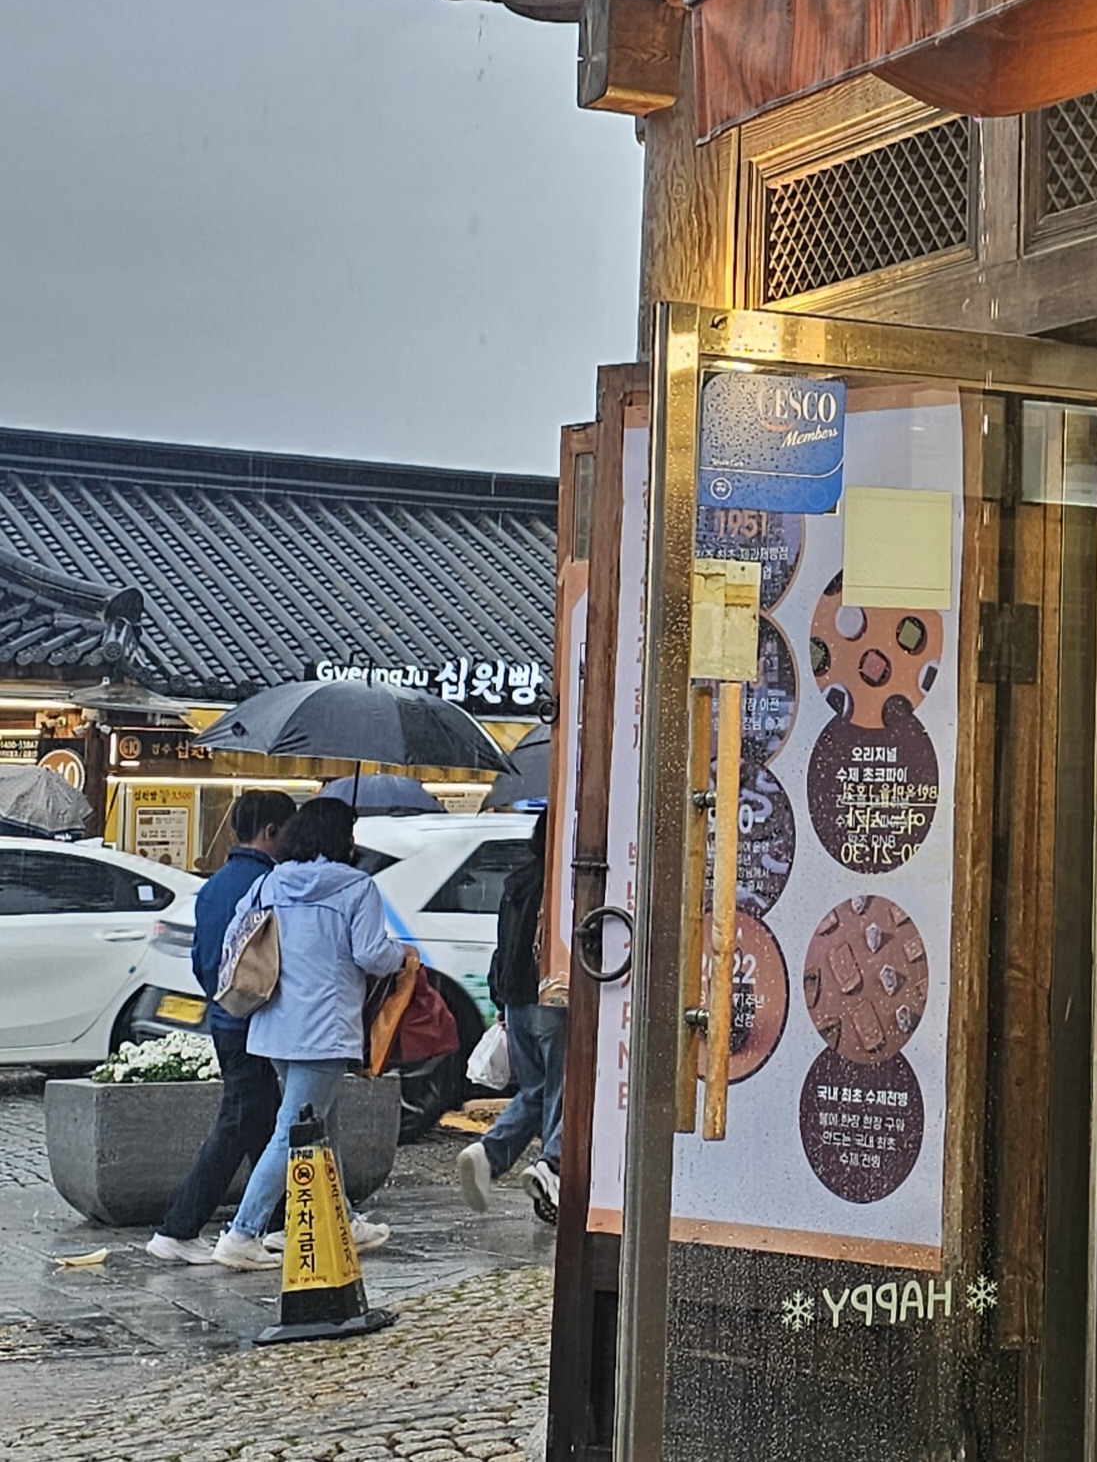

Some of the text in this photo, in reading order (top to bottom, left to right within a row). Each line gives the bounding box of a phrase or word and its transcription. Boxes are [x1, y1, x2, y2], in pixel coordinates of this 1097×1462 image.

[757, 389, 837, 424] CESCO
[781, 425, 839, 449] Members
[434, 655, 545, 706] 십원빵
[851, 746, 898, 763] 오리지널
[835, 766, 909, 783] 수제 초코파이
[816, 1085, 839, 1102] 국내
[295, 1188, 316, 1273] 주차금지
